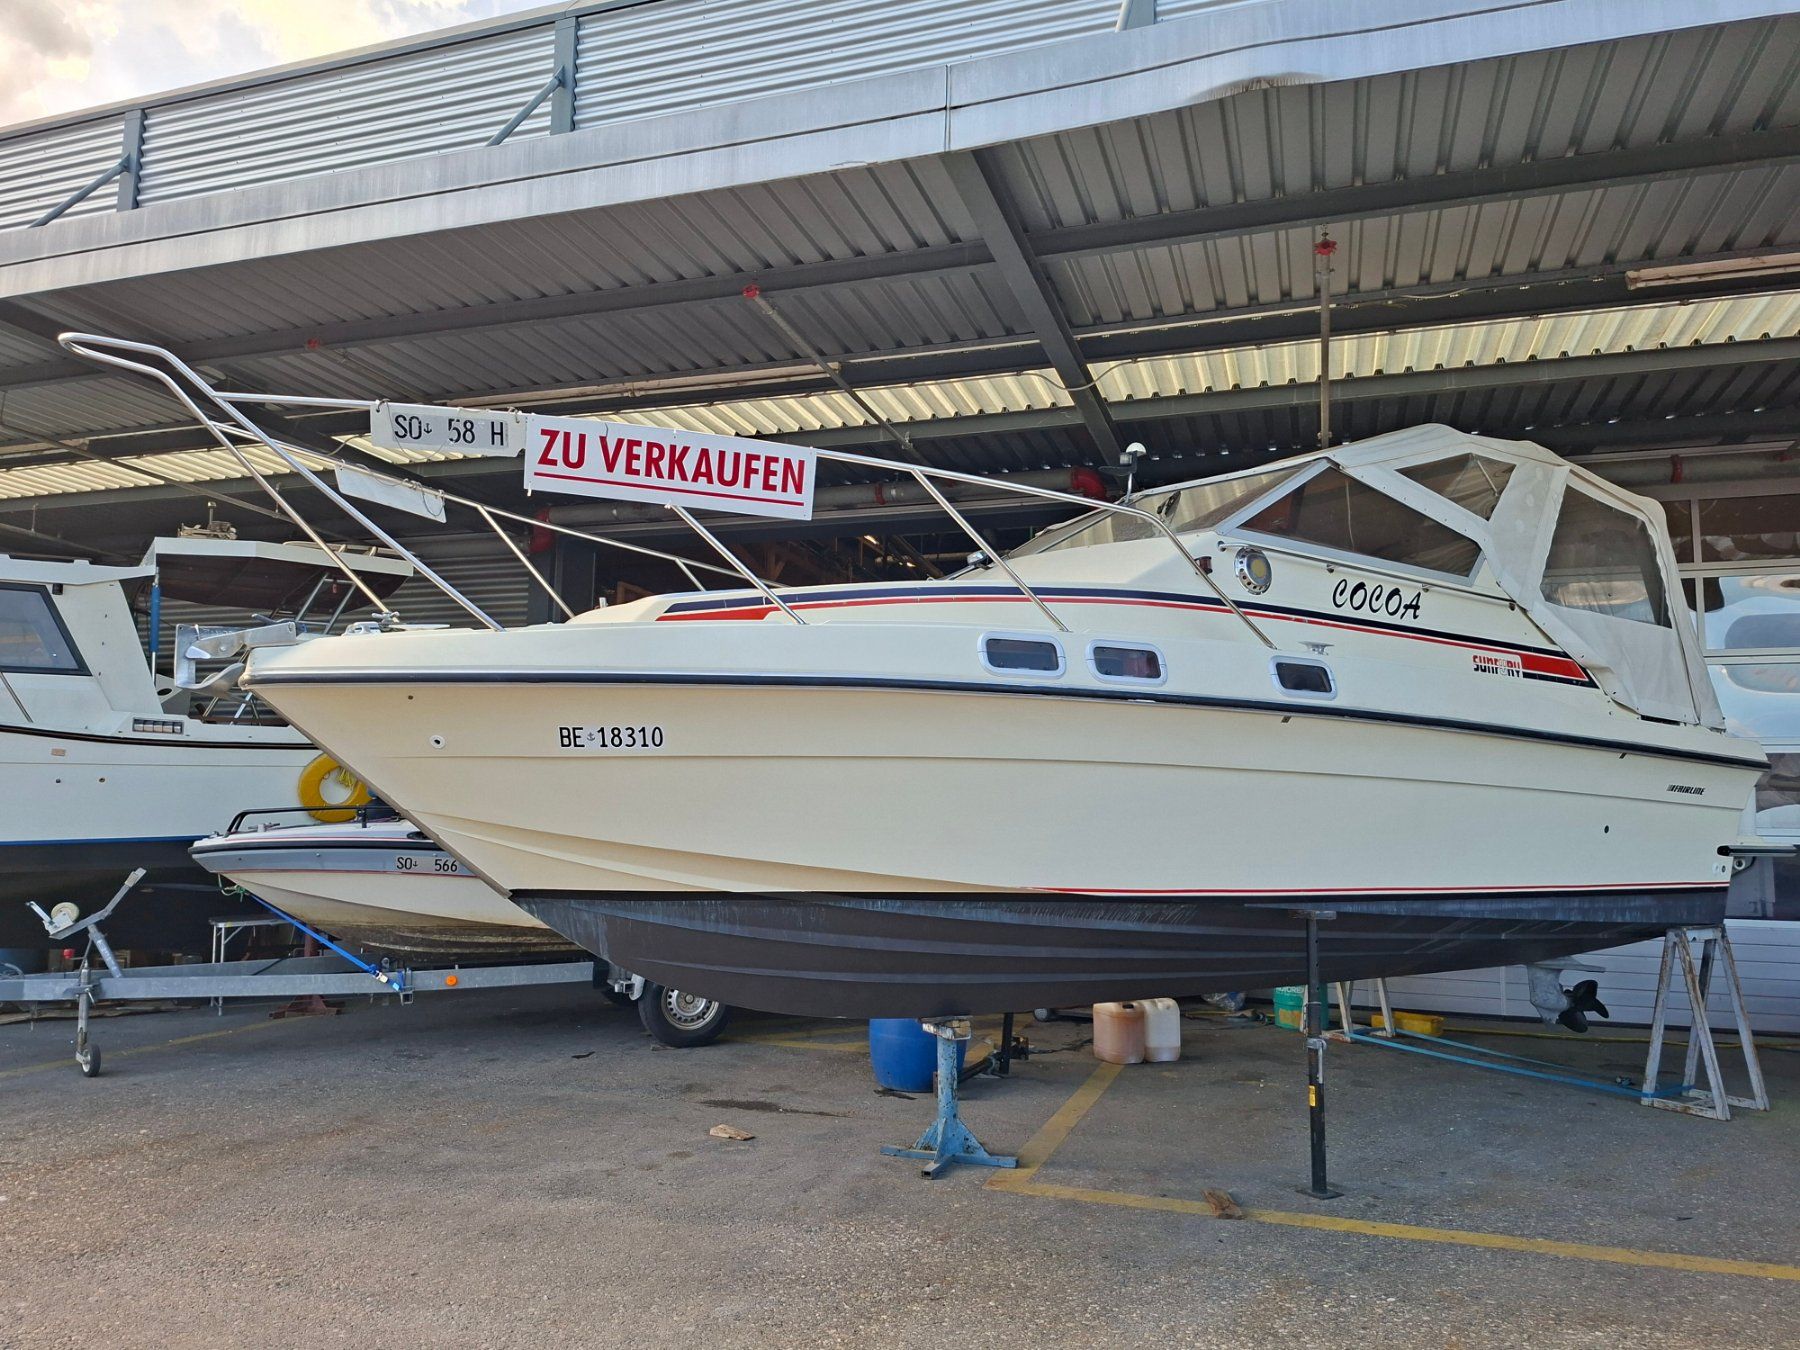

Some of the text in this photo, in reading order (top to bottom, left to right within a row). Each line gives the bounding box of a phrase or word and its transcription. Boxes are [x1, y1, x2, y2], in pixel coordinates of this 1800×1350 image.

[394, 414, 504, 446] SO 58 H
[537, 428, 806, 495] ZU VERKAUFEN
[1332, 578, 1422, 620] COCOA
[559, 726, 664, 748] BE 18310
[1673, 784, 1706, 796] FAIRLINE
[396, 856, 458, 873] SO 566
